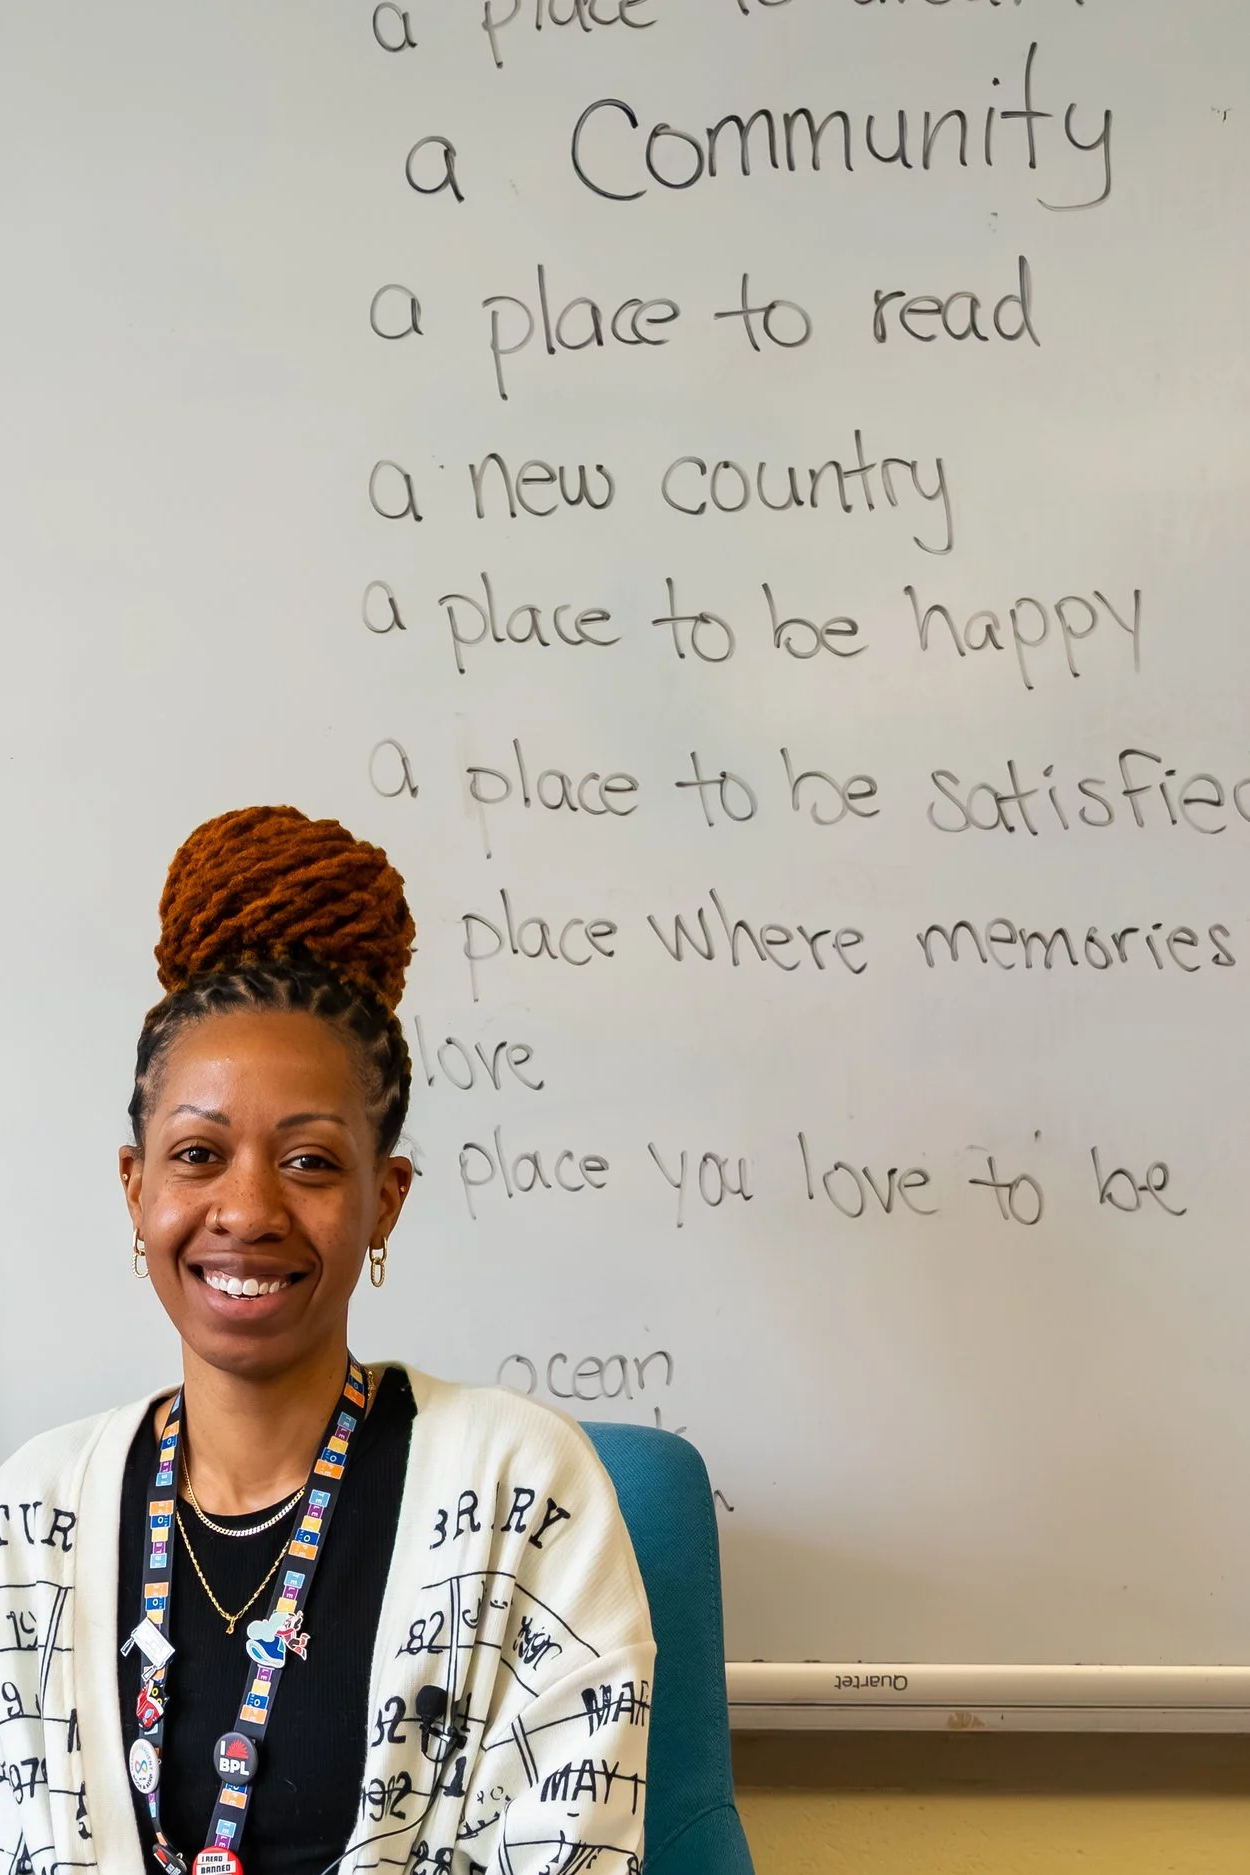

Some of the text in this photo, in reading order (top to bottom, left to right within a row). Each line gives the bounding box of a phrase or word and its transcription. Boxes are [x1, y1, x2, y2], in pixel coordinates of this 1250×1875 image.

[372, 0, 418, 52] a
[404, 134, 464, 203] a
[369, 254, 1042, 401] a place to read
[368, 429, 954, 555] a new country
[360, 571, 1143, 691] a place to be happy
[368, 738, 419, 799] a
[466, 738, 641, 860] place
[675, 750, 759, 828] to
[781, 746, 881, 827] be
[461, 887, 619, 1003] place
[915, 914, 1236, 972] memories
[414, 1016, 545, 1091] love
[460, 1124, 1188, 1228] place you love to be
[497, 1349, 675, 1401] ocean
[833, 1674, 909, 1692] Quartet
[219, 1758, 250, 1776] BPL
[540, 1758, 620, 1804] MAY
